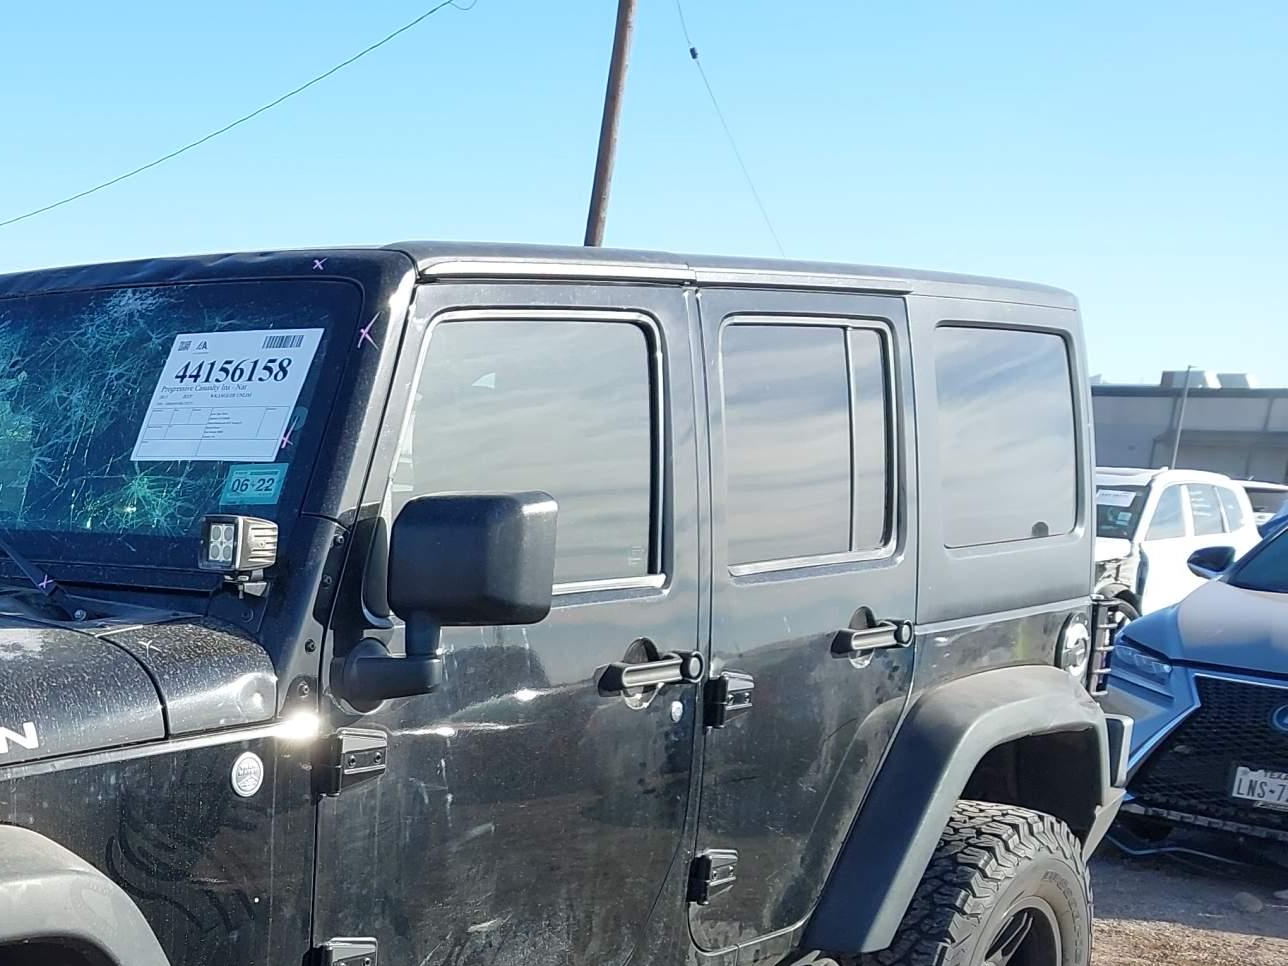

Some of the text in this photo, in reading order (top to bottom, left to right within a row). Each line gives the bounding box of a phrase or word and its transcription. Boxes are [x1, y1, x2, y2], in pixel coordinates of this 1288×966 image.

[174, 358, 292, 384] 44156158
[232, 477, 275, 492] 06 22
[1236, 778, 1288, 803] LNS-7
